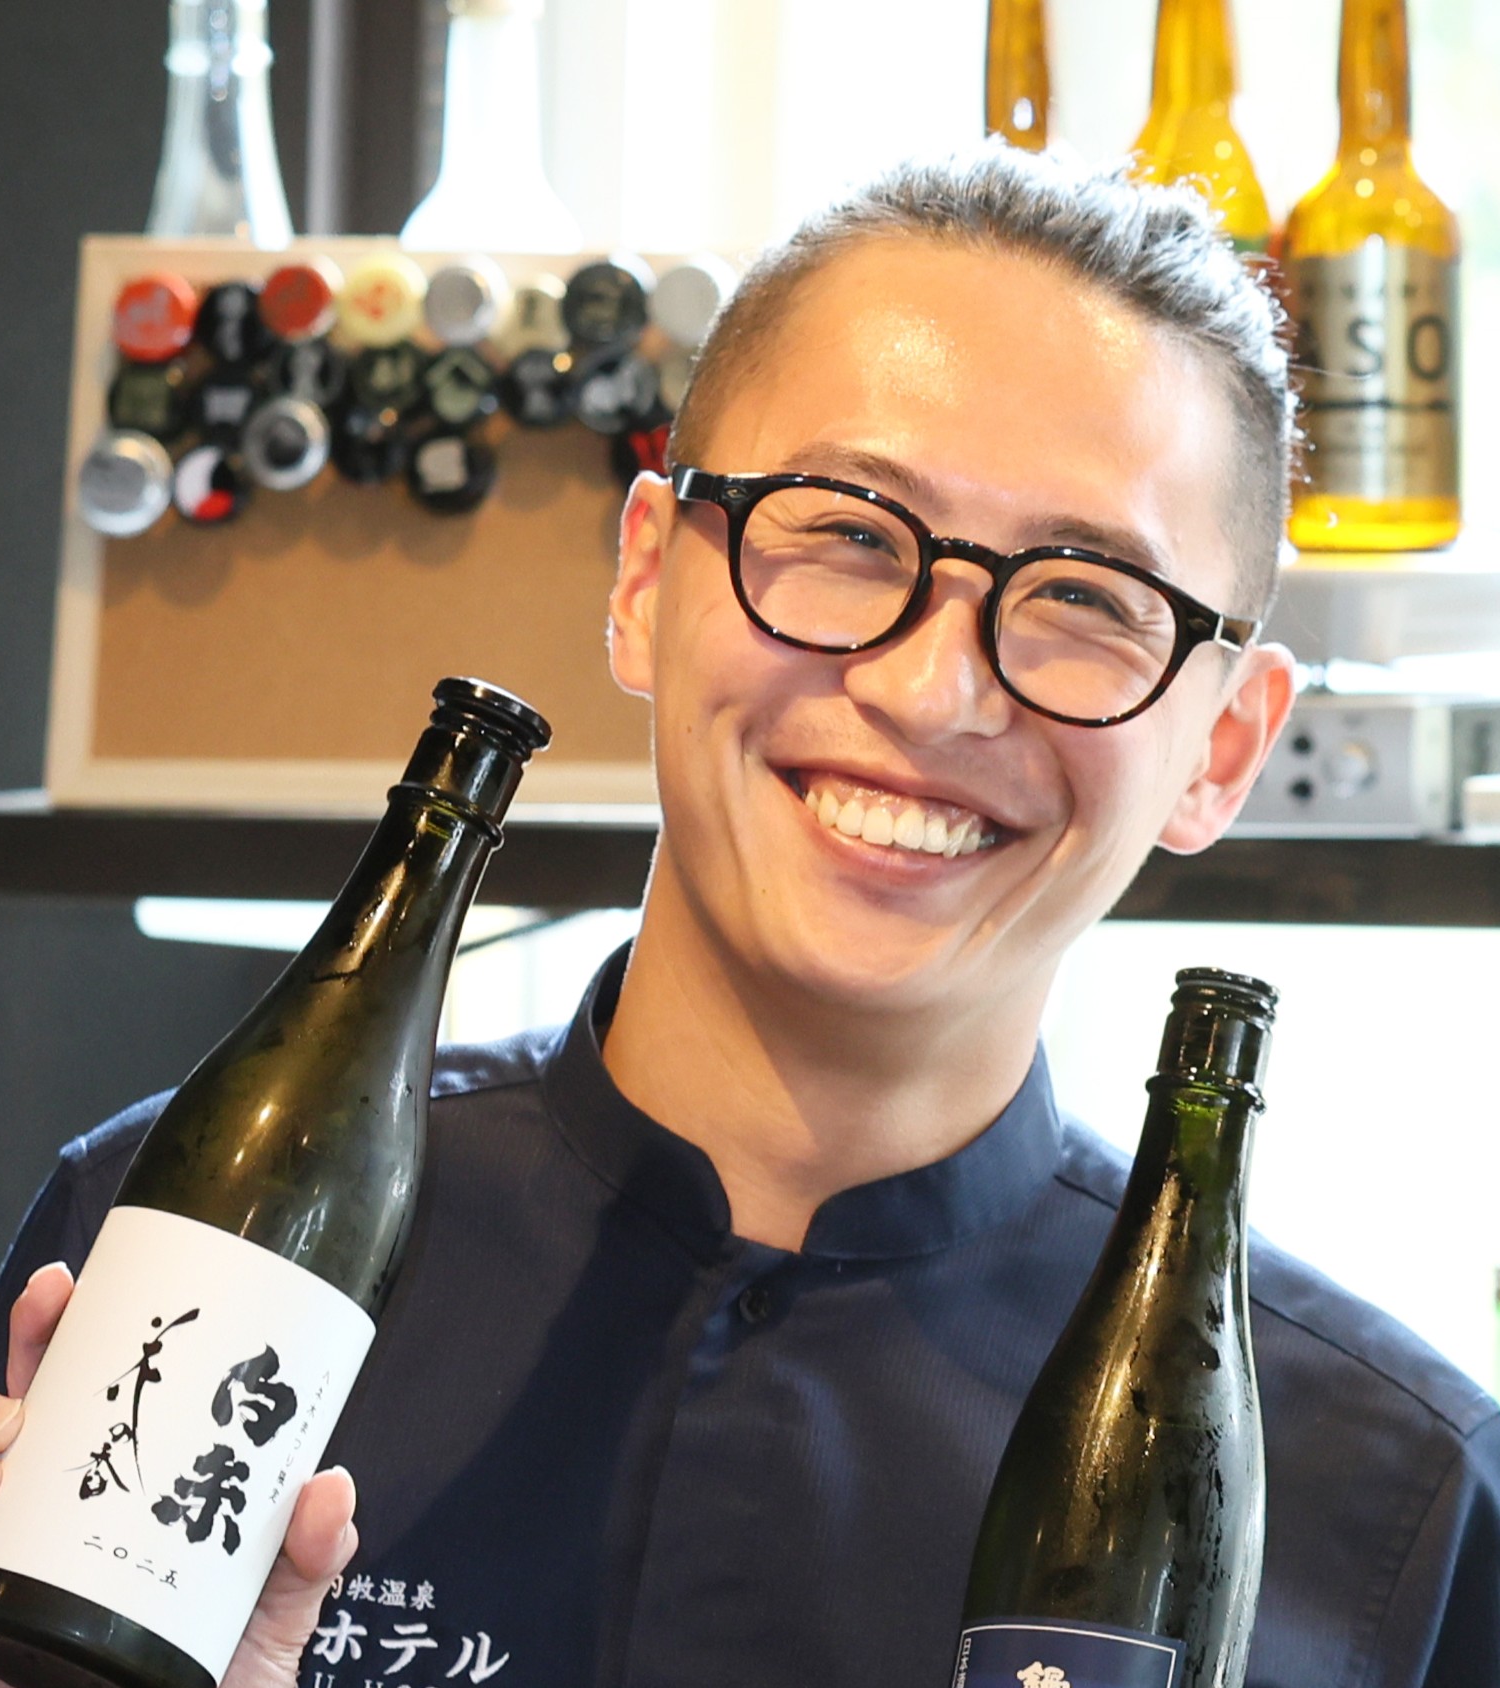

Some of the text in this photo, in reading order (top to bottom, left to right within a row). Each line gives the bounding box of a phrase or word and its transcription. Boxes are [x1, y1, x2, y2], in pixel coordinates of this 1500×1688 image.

[65, 1308, 200, 1500] 花の香
[151, 1341, 298, 1557] 白糸
[311, 1608, 511, 1685] ホテル
